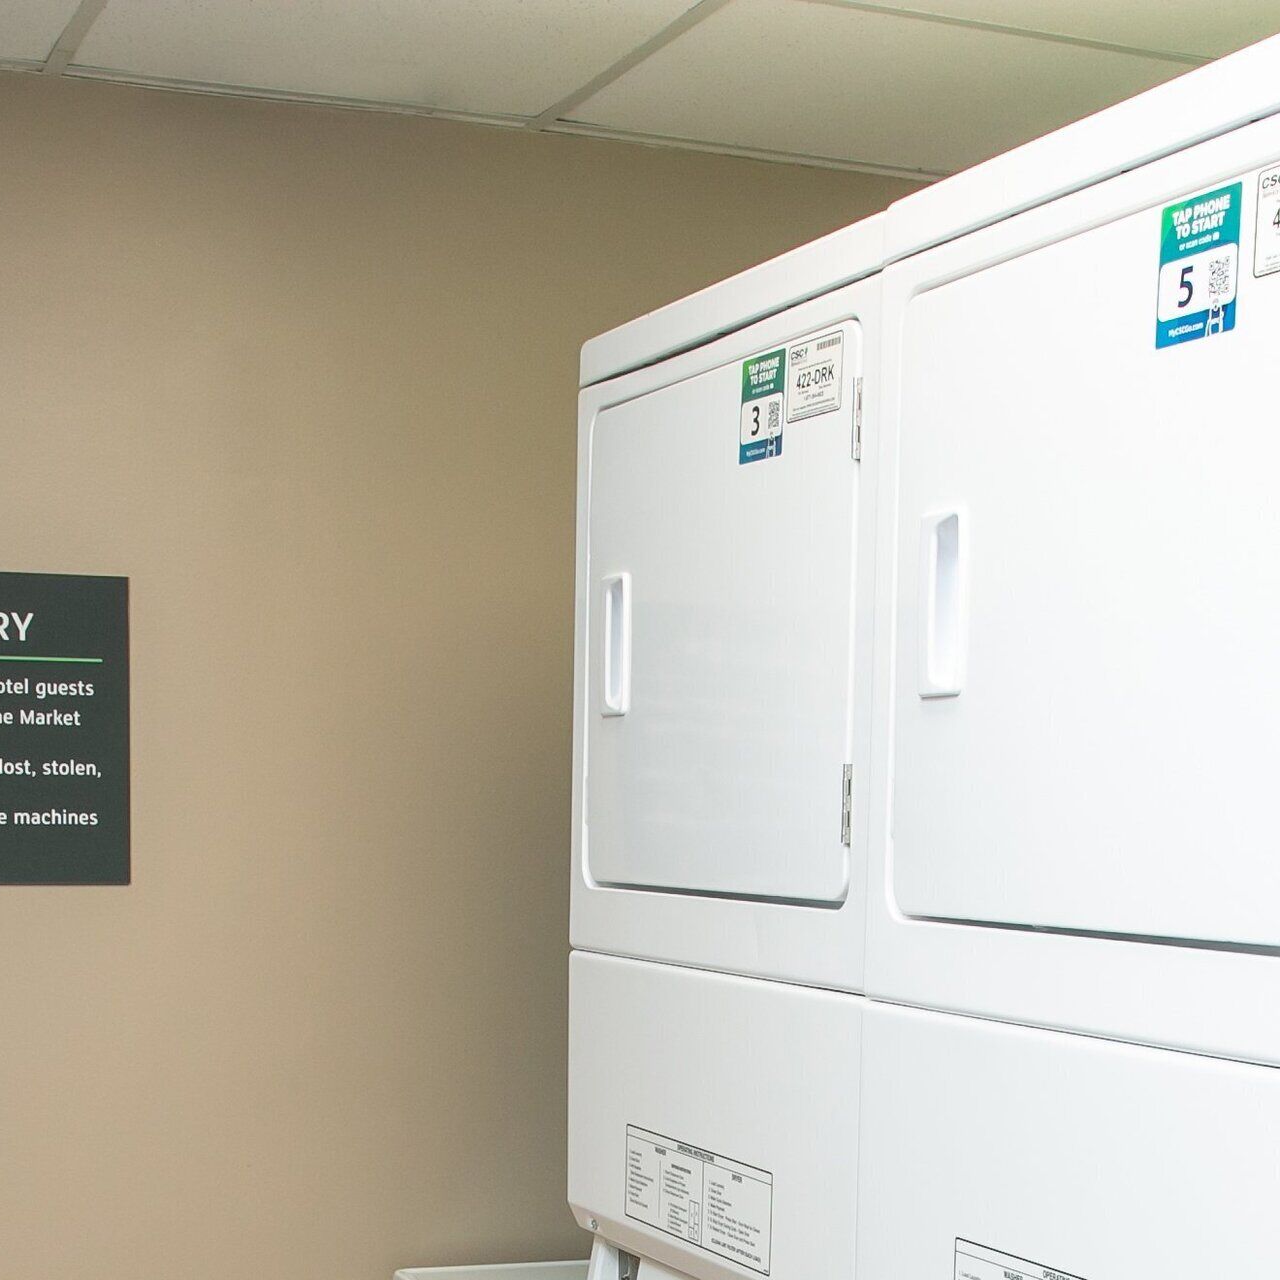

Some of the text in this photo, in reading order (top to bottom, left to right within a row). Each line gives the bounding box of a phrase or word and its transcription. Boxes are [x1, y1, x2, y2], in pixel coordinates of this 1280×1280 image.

[1172, 194, 1231, 227] TAP PHONE
[1176, 211, 1226, 240] TO START
[1177, 265, 1194, 308] 5
[748, 356, 780, 375] TAP PHONE
[791, 349, 804, 361] CSC
[750, 368, 777, 386] TO START
[796, 363, 835, 391] 422-DRK
[751, 405, 760, 436] 3
[34, 679, 95, 700] guests
[19, 707, 82, 727] Market
[41, 757, 102, 778] stolen,
[12, 807, 99, 826] machines
